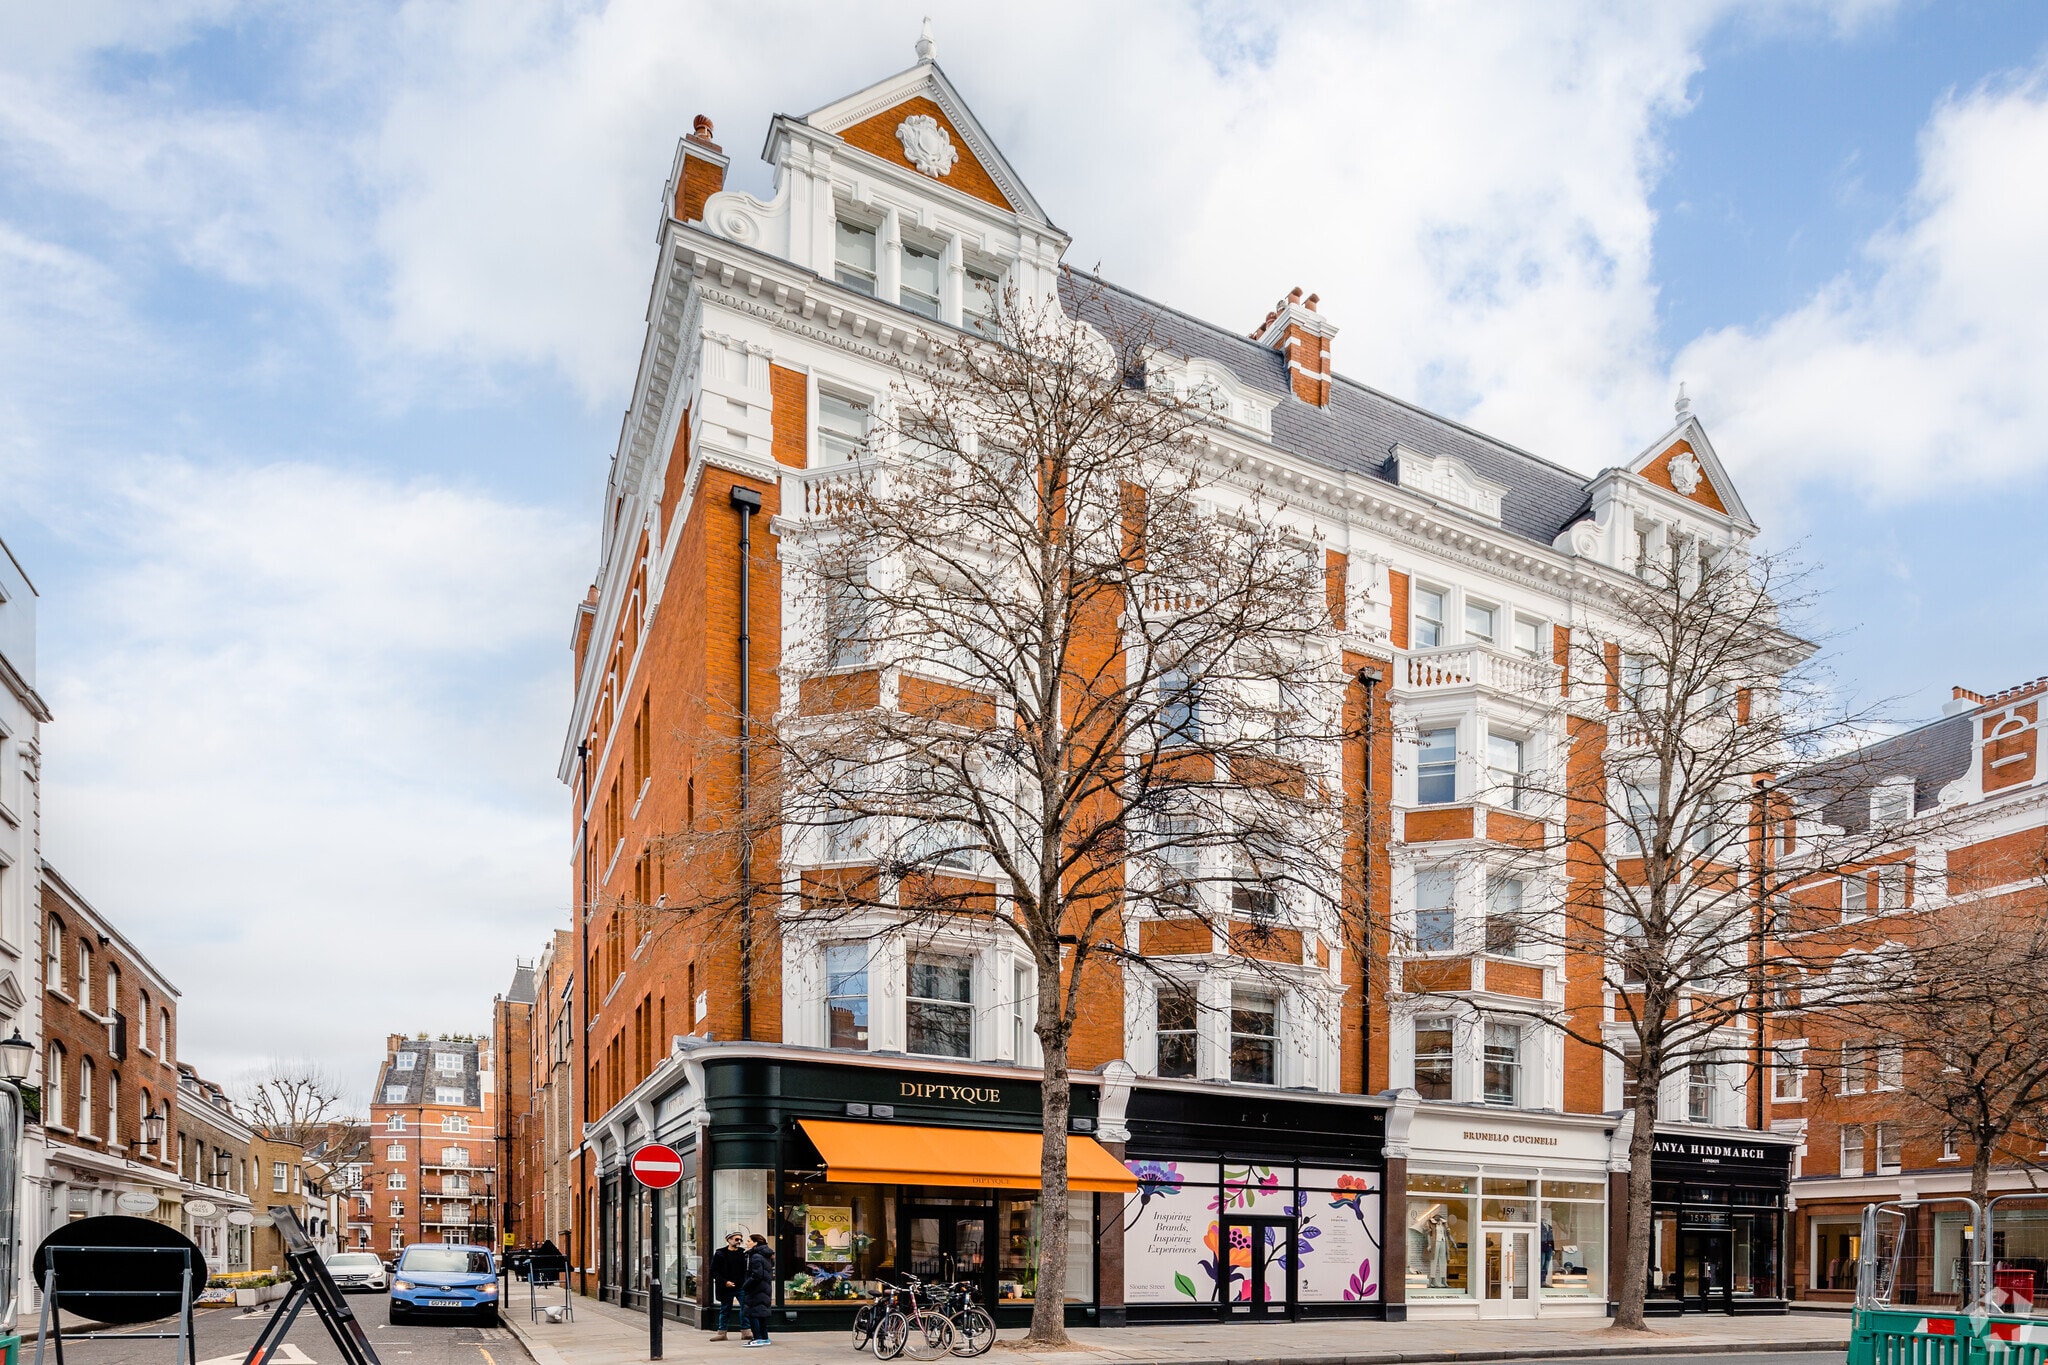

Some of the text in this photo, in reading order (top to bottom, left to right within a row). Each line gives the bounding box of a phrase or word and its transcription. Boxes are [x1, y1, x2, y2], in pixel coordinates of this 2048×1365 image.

[900, 1082, 1000, 1104] DIPTYQUE
[1463, 1131, 1558, 1146] BRUNELLO CUCINELLI
[1653, 1142, 1765, 1159] ANYA HINDMARCH
[1502, 1207, 1515, 1215] 159
[829, 1215, 849, 1223] SON
[1153, 1212, 1192, 1223] Inspiring
[1156, 1223, 1189, 1232] Brands,
[1153, 1234, 1192, 1245] Inspiring
[1147, 1245, 1197, 1256] Experiences
